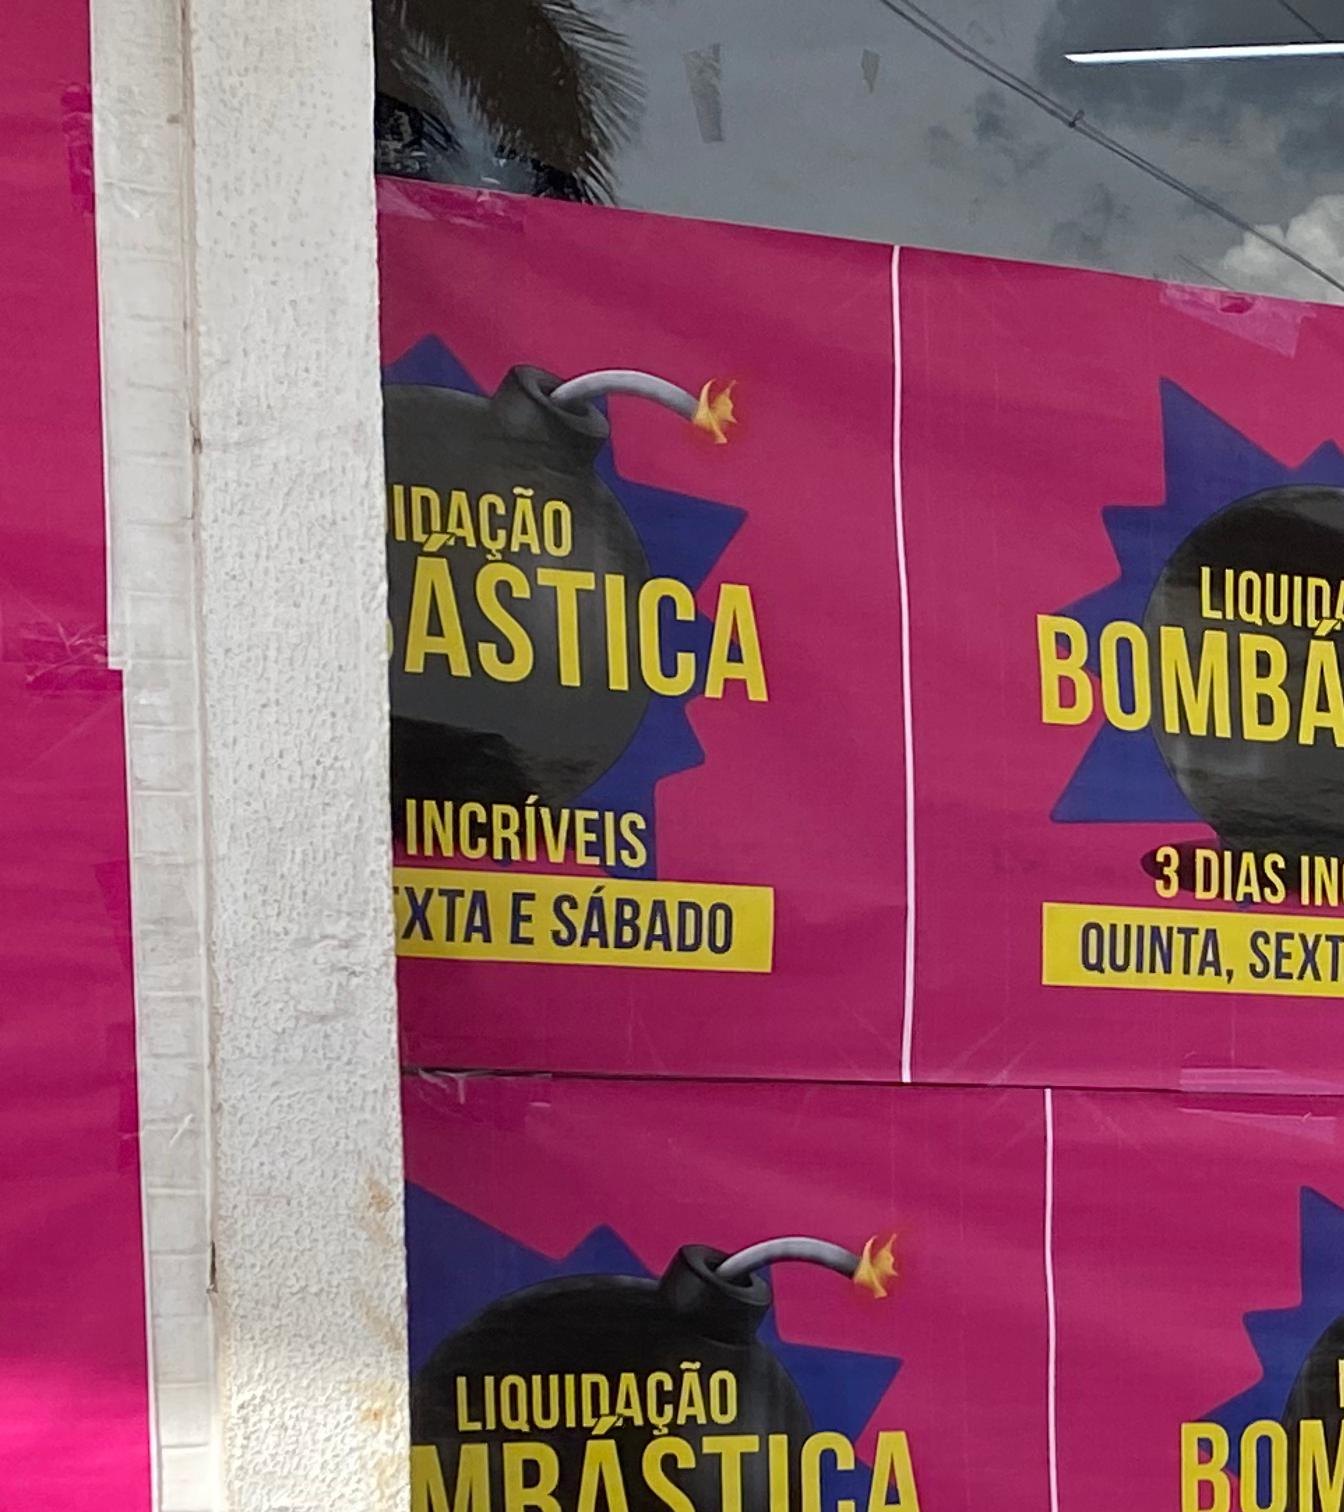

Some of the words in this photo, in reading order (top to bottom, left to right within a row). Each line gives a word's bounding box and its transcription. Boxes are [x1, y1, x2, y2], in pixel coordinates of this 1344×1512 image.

[394, 484, 572, 562] IDAÇÃO
[403, 531, 769, 703] ÁSTICA
[407, 796, 647, 867] INCRÍVEIS
[1154, 846, 1179, 898] 3
[1194, 848, 1286, 904] DIAS
[395, 888, 493, 946] XTA
[511, 894, 535, 946] E
[552, 887, 733, 955] SÁBADO
[1080, 921, 1234, 984] QUINTA,
[456, 1362, 738, 1436] LIQUIDAÇÃO
